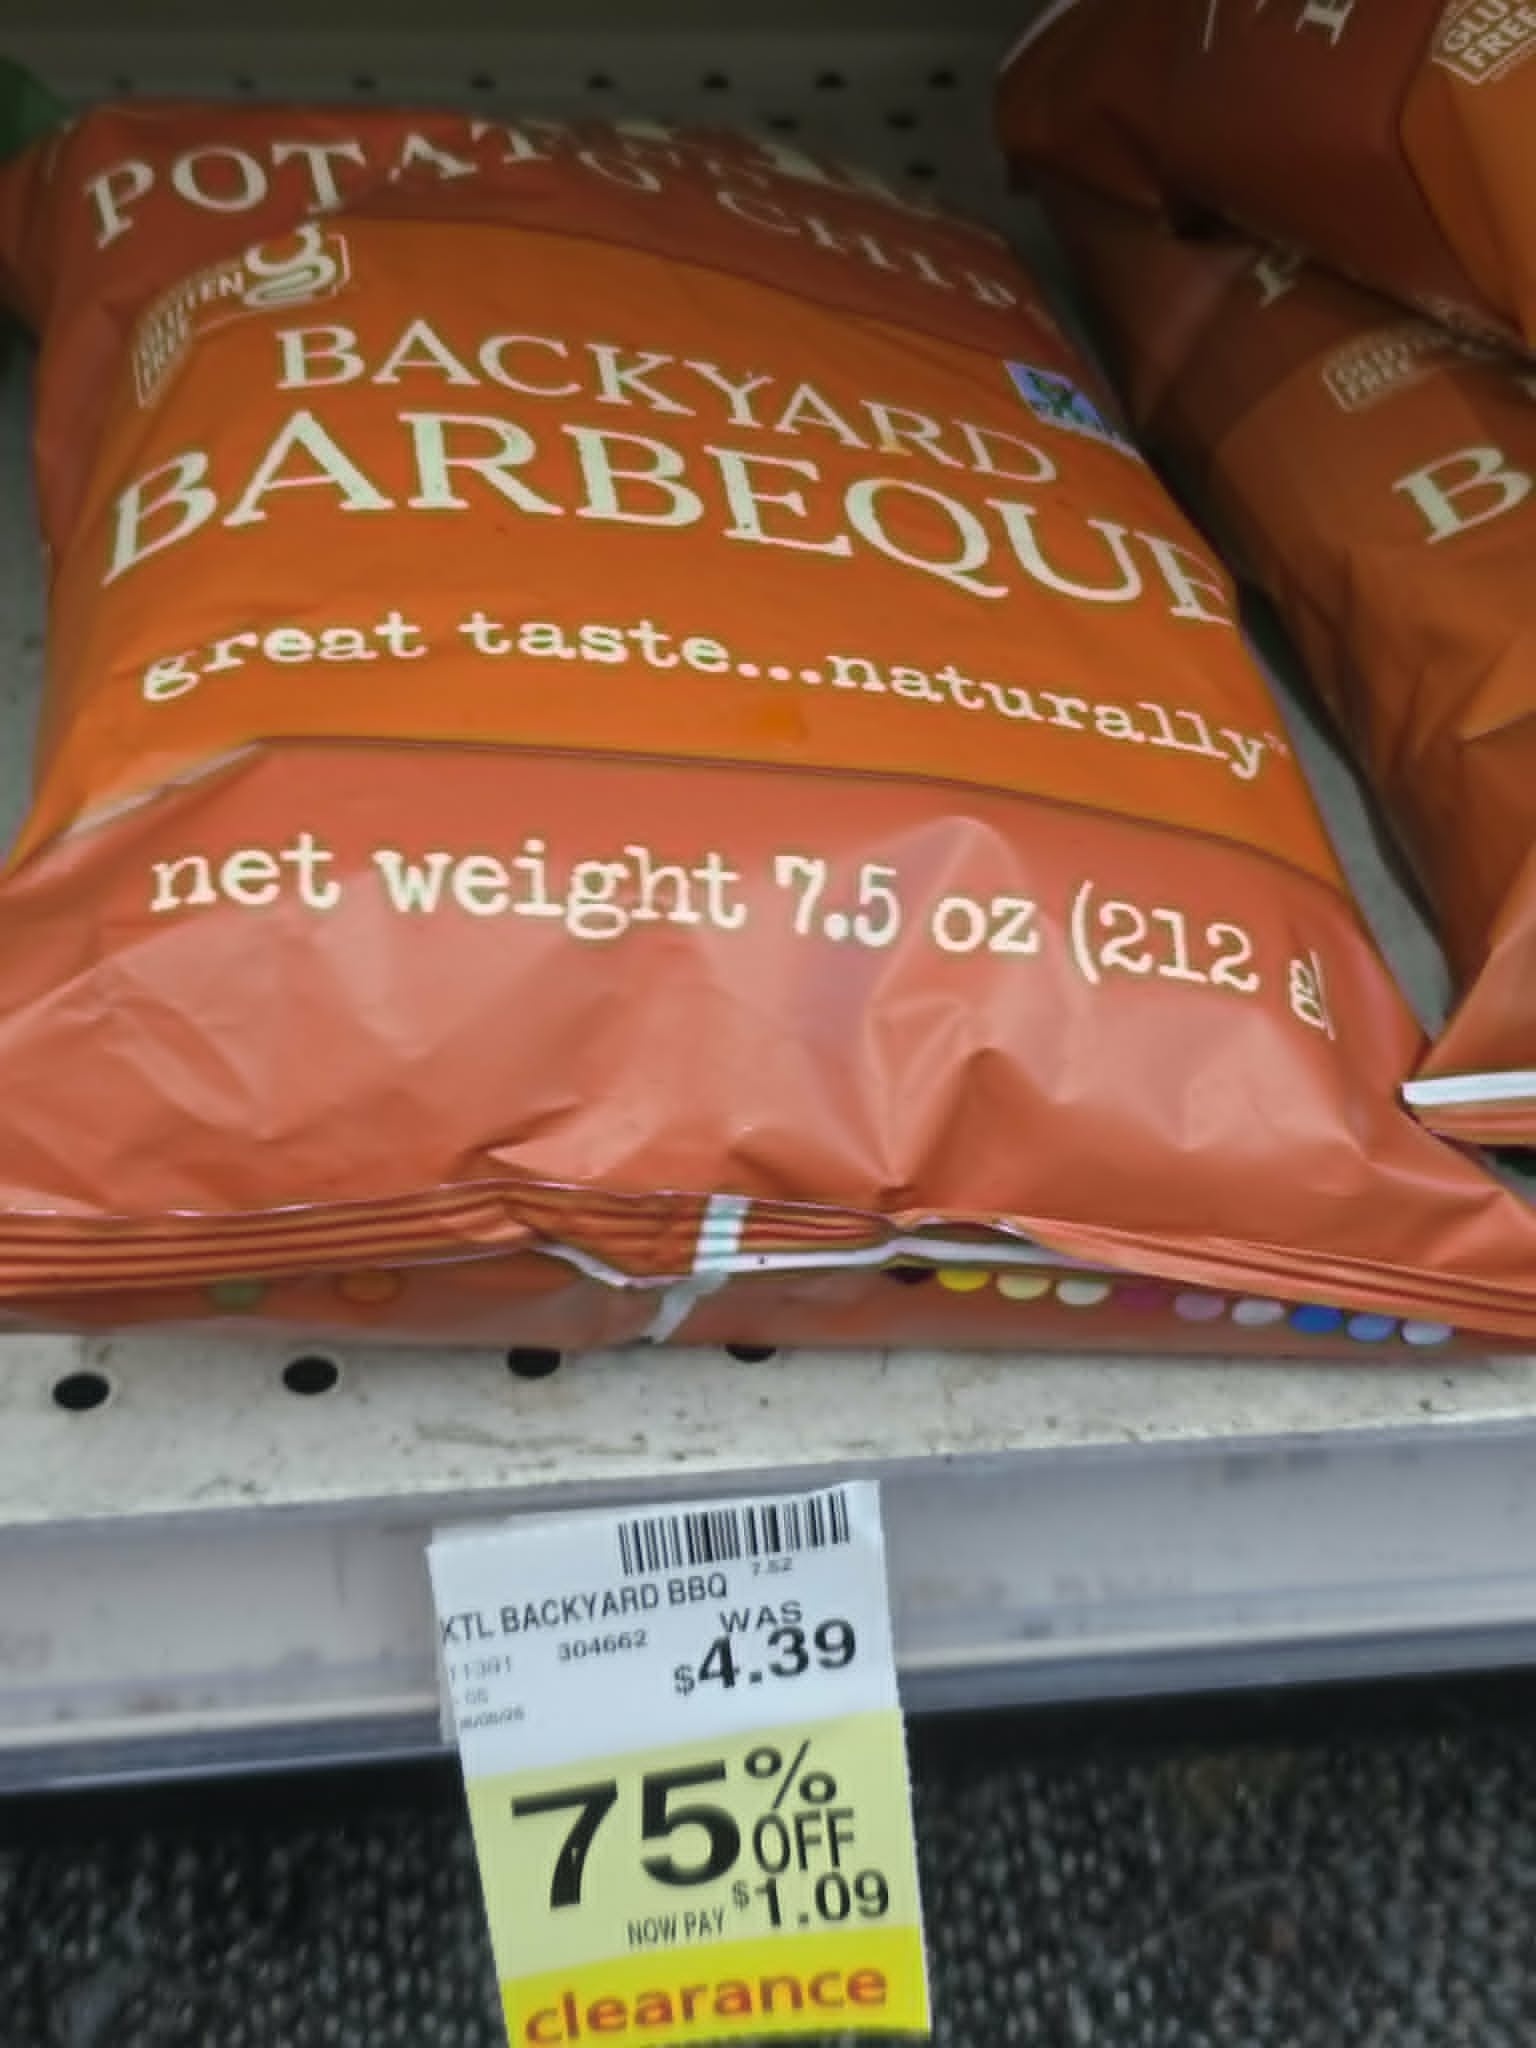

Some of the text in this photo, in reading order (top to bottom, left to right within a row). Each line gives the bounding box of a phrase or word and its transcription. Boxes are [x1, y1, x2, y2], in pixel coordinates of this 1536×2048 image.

[275, 318, 1058, 484] BACKYARD
[143, 611, 428, 701] great
[149, 832, 342, 913] net
[372, 838, 748, 940] weight
[774, 855, 897, 946] 7.5
[932, 896, 1040, 954] oz
[1072, 880, 1260, 992] (212
[500, 1585, 660, 1637] BACKYARD
[667, 1571, 729, 1608] BBQ
[719, 1600, 803, 1634] WAS
[557, 1630, 649, 1664] 304662
[674, 1618, 857, 1697] $4.39
[753, 1807, 854, 1874] OFF
[627, 1868, 889, 1947] NOW PAY $1.09
[524, 1967, 890, 2046] clearance
